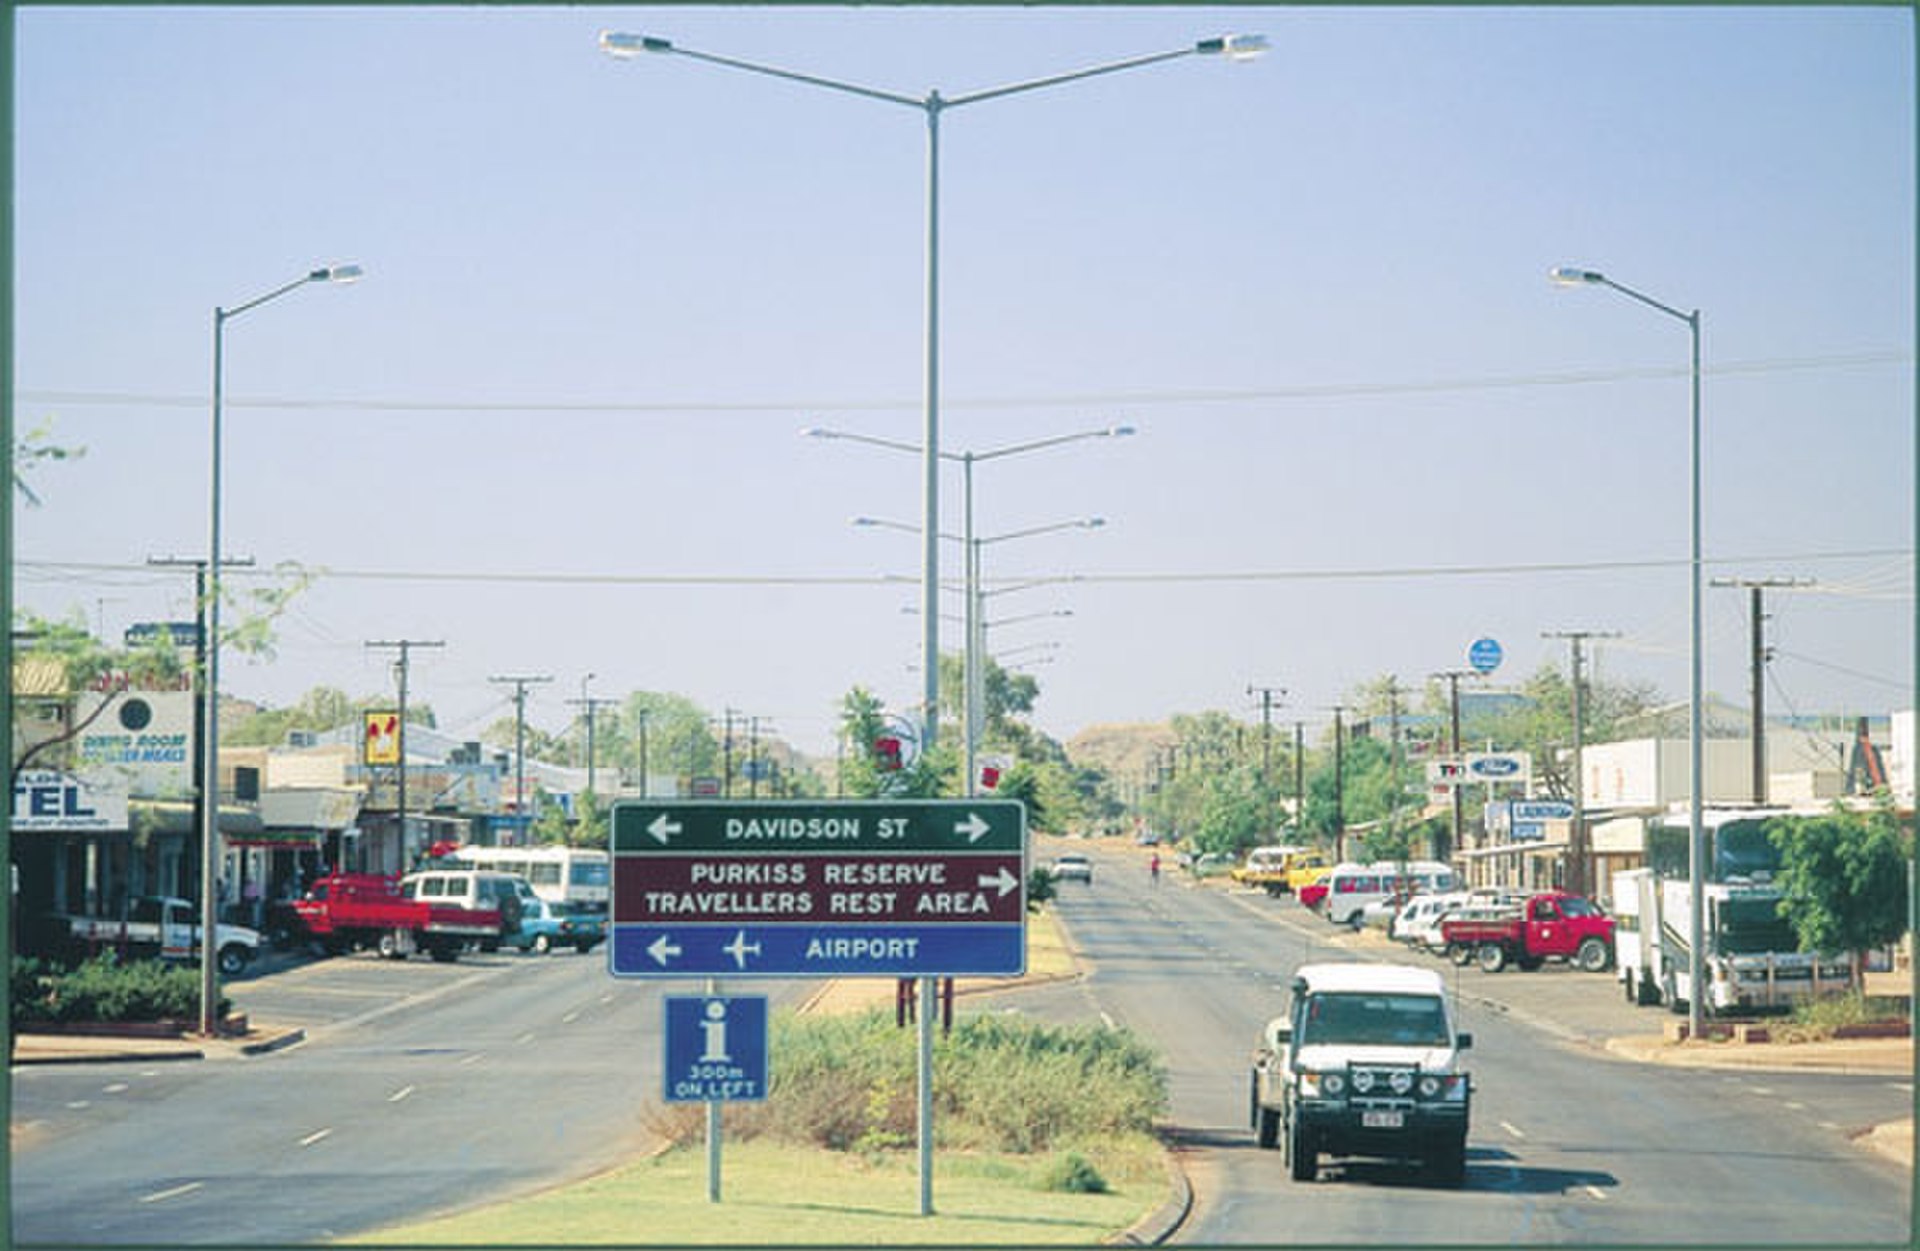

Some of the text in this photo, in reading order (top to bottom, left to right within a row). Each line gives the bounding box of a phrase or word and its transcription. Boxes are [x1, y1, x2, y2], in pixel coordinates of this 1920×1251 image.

[137, 734, 187, 746] ROOM
[726, 818, 909, 839] DAVIDSON ST
[691, 863, 947, 885] PURKISS RESERVE
[645, 891, 990, 915] TRAVELLERS REST AREA
[805, 938, 919, 959] AIRPORT
[689, 1065, 744, 1079] 300m
[675, 1081, 756, 1096] ON LEFT
